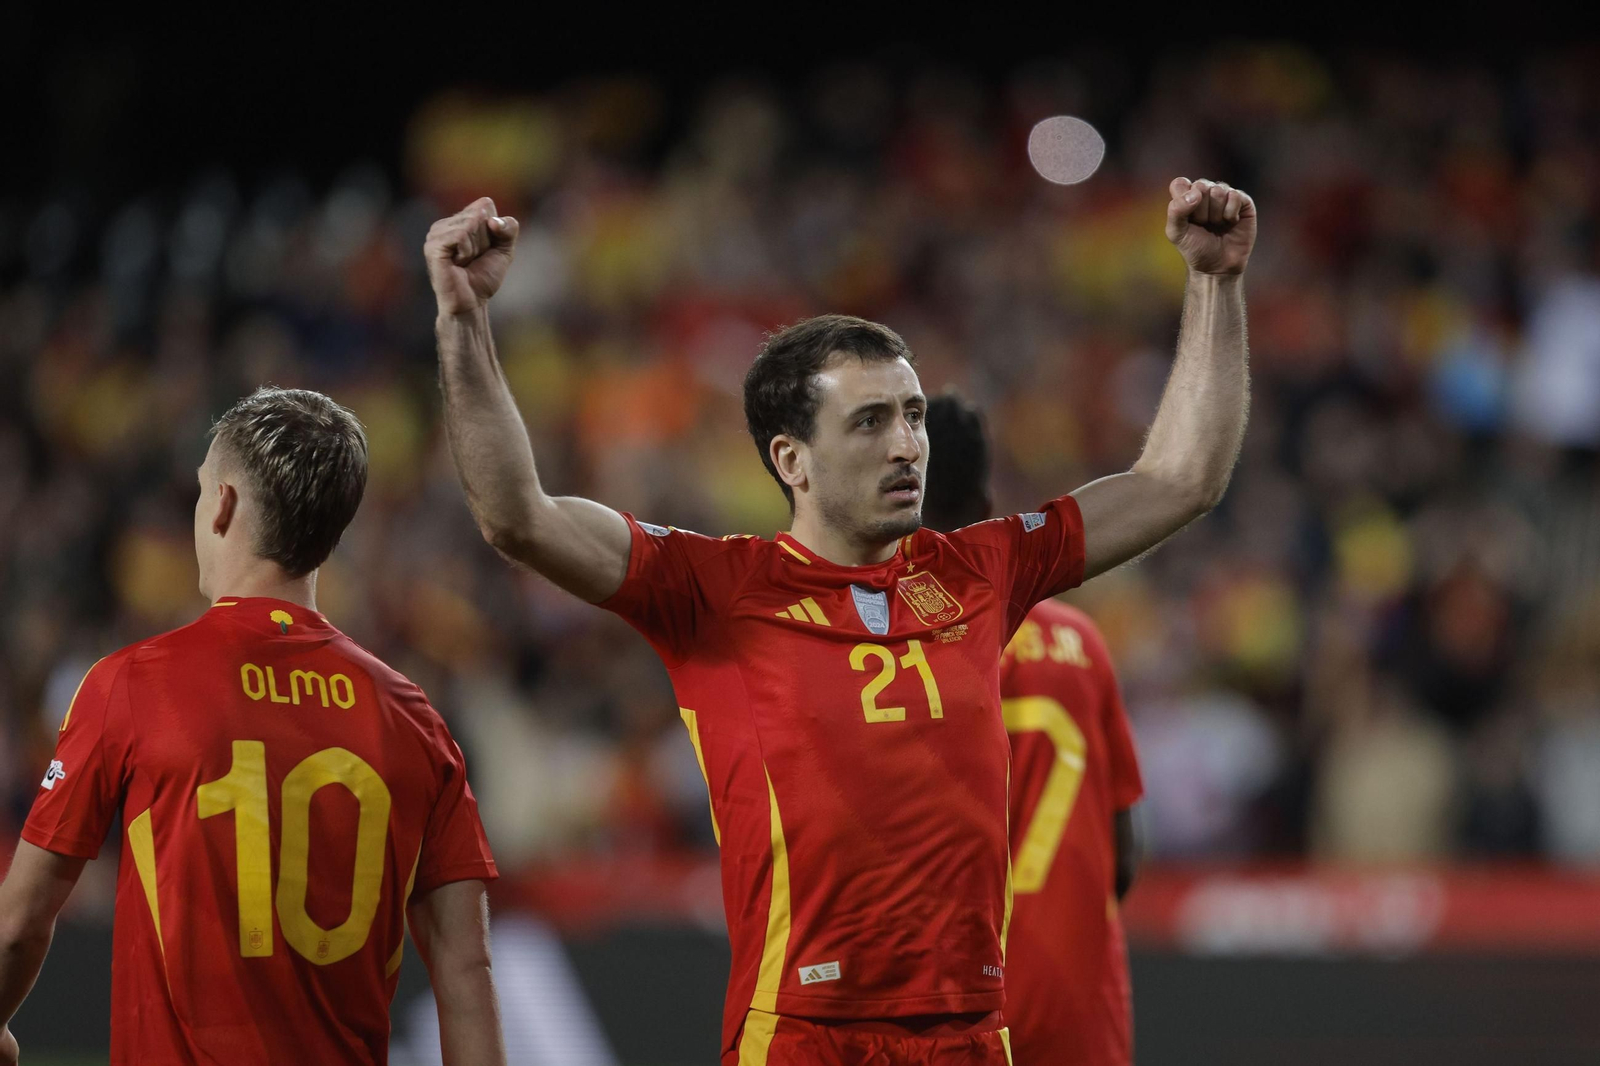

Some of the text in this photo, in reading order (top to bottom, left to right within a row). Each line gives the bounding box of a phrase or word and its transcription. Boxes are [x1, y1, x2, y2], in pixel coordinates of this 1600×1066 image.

[240, 663, 356, 709] OLMO
[849, 639, 944, 724] 21
[197, 740, 391, 966] 10
